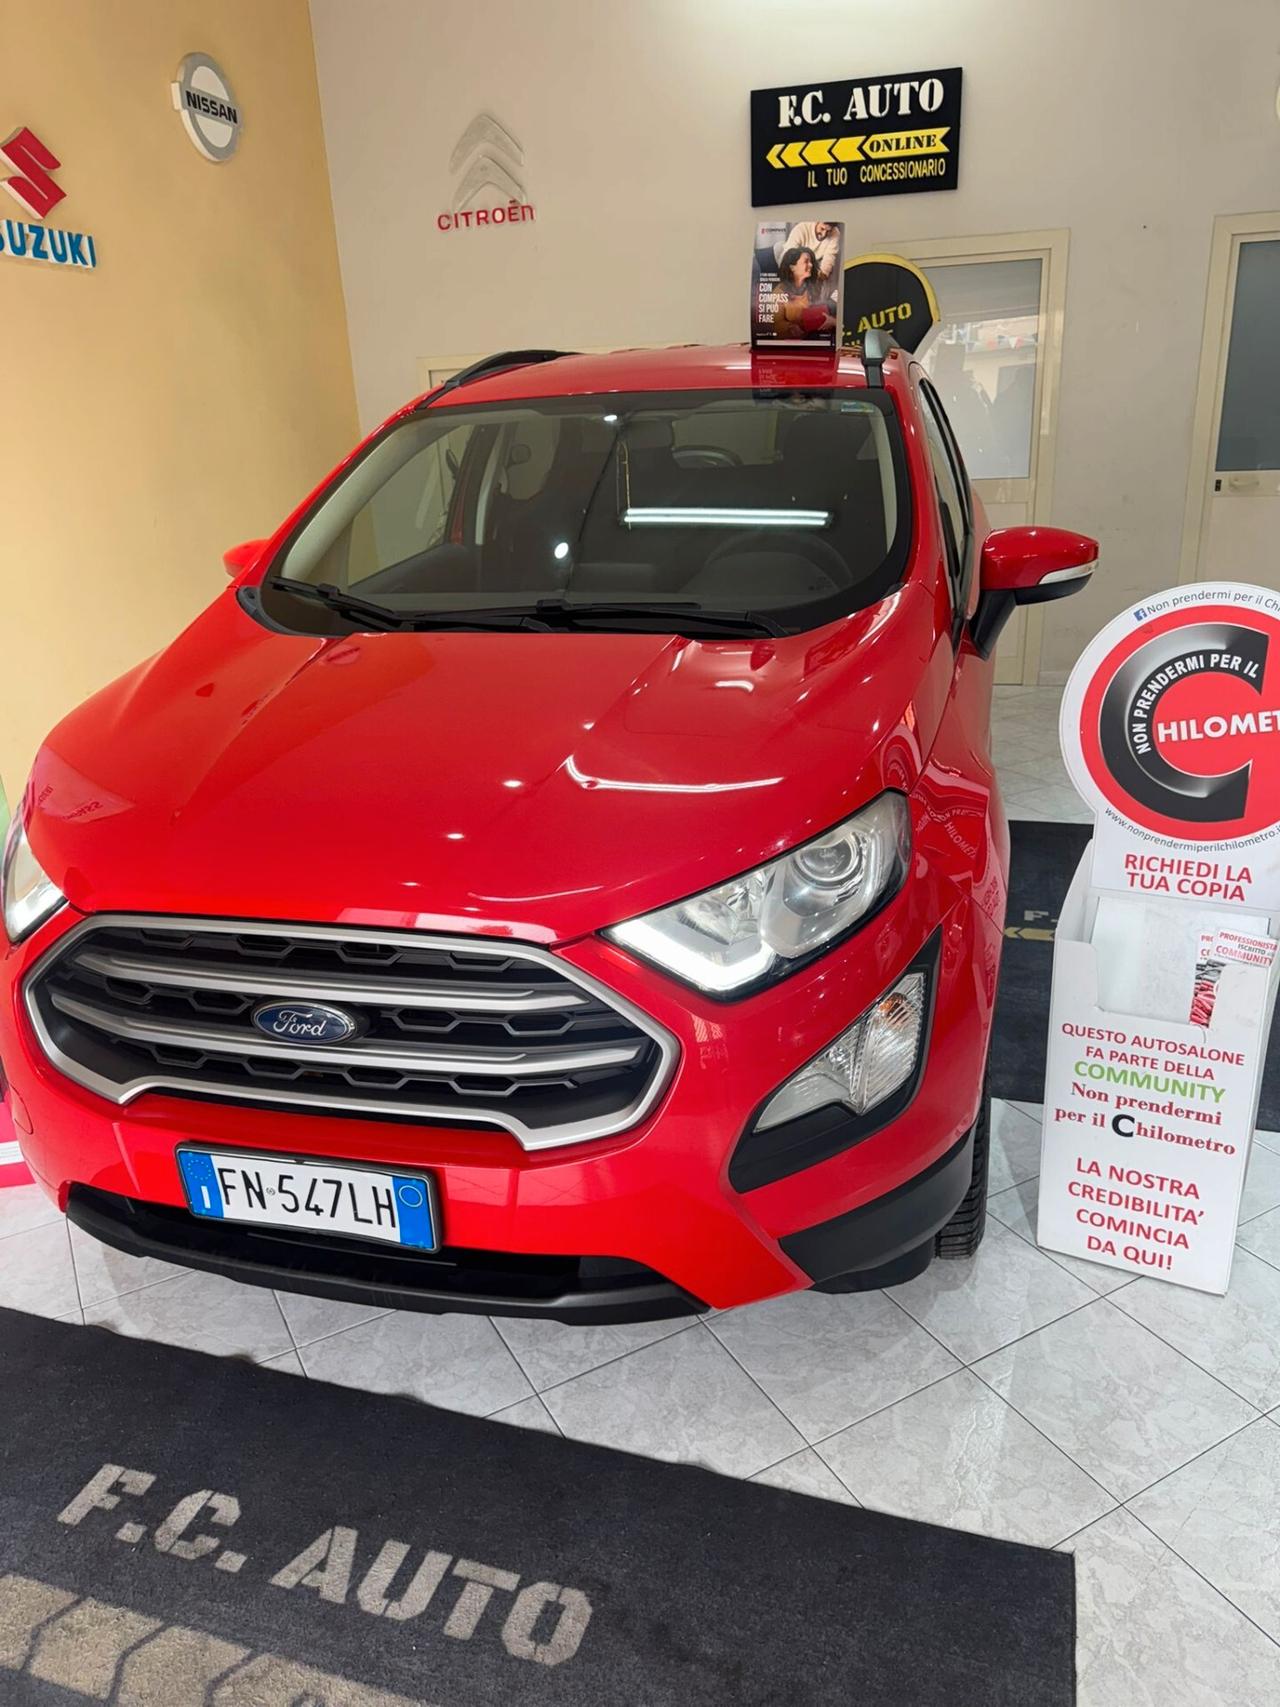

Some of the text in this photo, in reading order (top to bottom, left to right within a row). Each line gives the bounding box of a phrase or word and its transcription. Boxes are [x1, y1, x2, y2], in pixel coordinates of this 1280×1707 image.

[185, 90, 238, 124] NISSAN
[777, 78, 945, 128] F.C. AUTO
[869, 134, 937, 153] ONLINE
[807, 158, 946, 188] IL TUO CONCESSIONARIO
[0, 219, 97, 268] UZUKI
[758, 293, 789, 303] COMPASS
[759, 283, 772, 292] CON
[857, 303, 912, 333] AUTO
[1147, 600, 1170, 615] Non
[1172, 591, 1231, 605] prendermi
[1233, 591, 1254, 603] per
[1255, 595, 1264, 605] il
[1132, 653, 1260, 755] NON PRENDERMI PER IL
[1124, 853, 1252, 884] RICHIEDI LA
[1126, 872, 1245, 901] TUA COPIA
[1216, 945, 1272, 966] COMMUNITY
[273, 1011, 327, 1037] Ford
[1061, 1022, 1245, 1066] QUESTO AUTOSALONE
[1086, 1046, 1215, 1081] FA PARTE DELLA
[1074, 1061, 1226, 1104] COMMUNITY
[1071, 1081, 1223, 1126] Non prendermi
[1054, 1107, 1236, 1156] per il Chilometro
[1076, 1157, 1200, 1200] LA NOSTRA
[1076, 1208, 1190, 1250] COMINCIA
[1087, 1235, 1173, 1271] DA QUI!
[56, 1463, 593, 1667] F.C. AUTO
